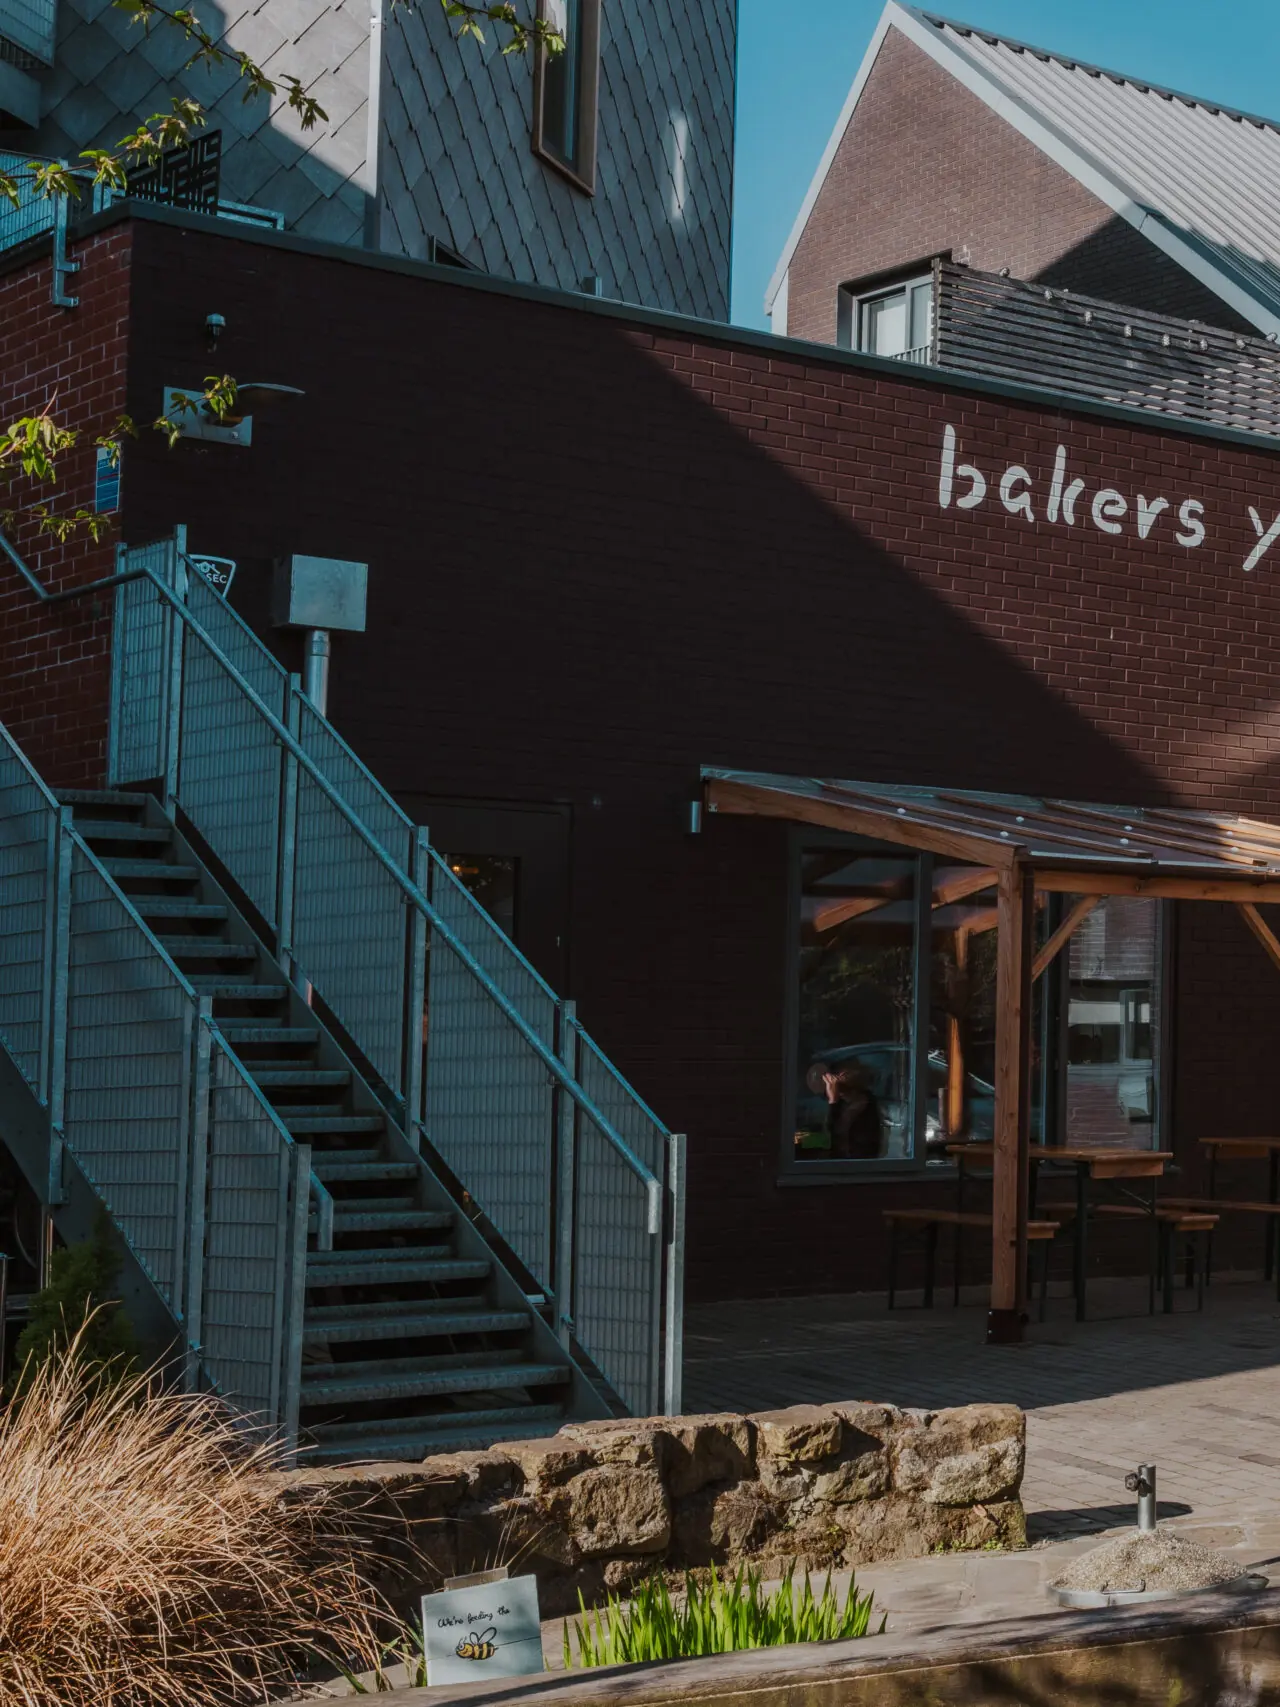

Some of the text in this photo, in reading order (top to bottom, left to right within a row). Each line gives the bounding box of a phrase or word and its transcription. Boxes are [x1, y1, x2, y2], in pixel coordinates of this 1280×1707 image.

[938, 424, 1206, 548] bakers
[467, 1610, 493, 1625] feeding
[497, 1605, 511, 1616] the
